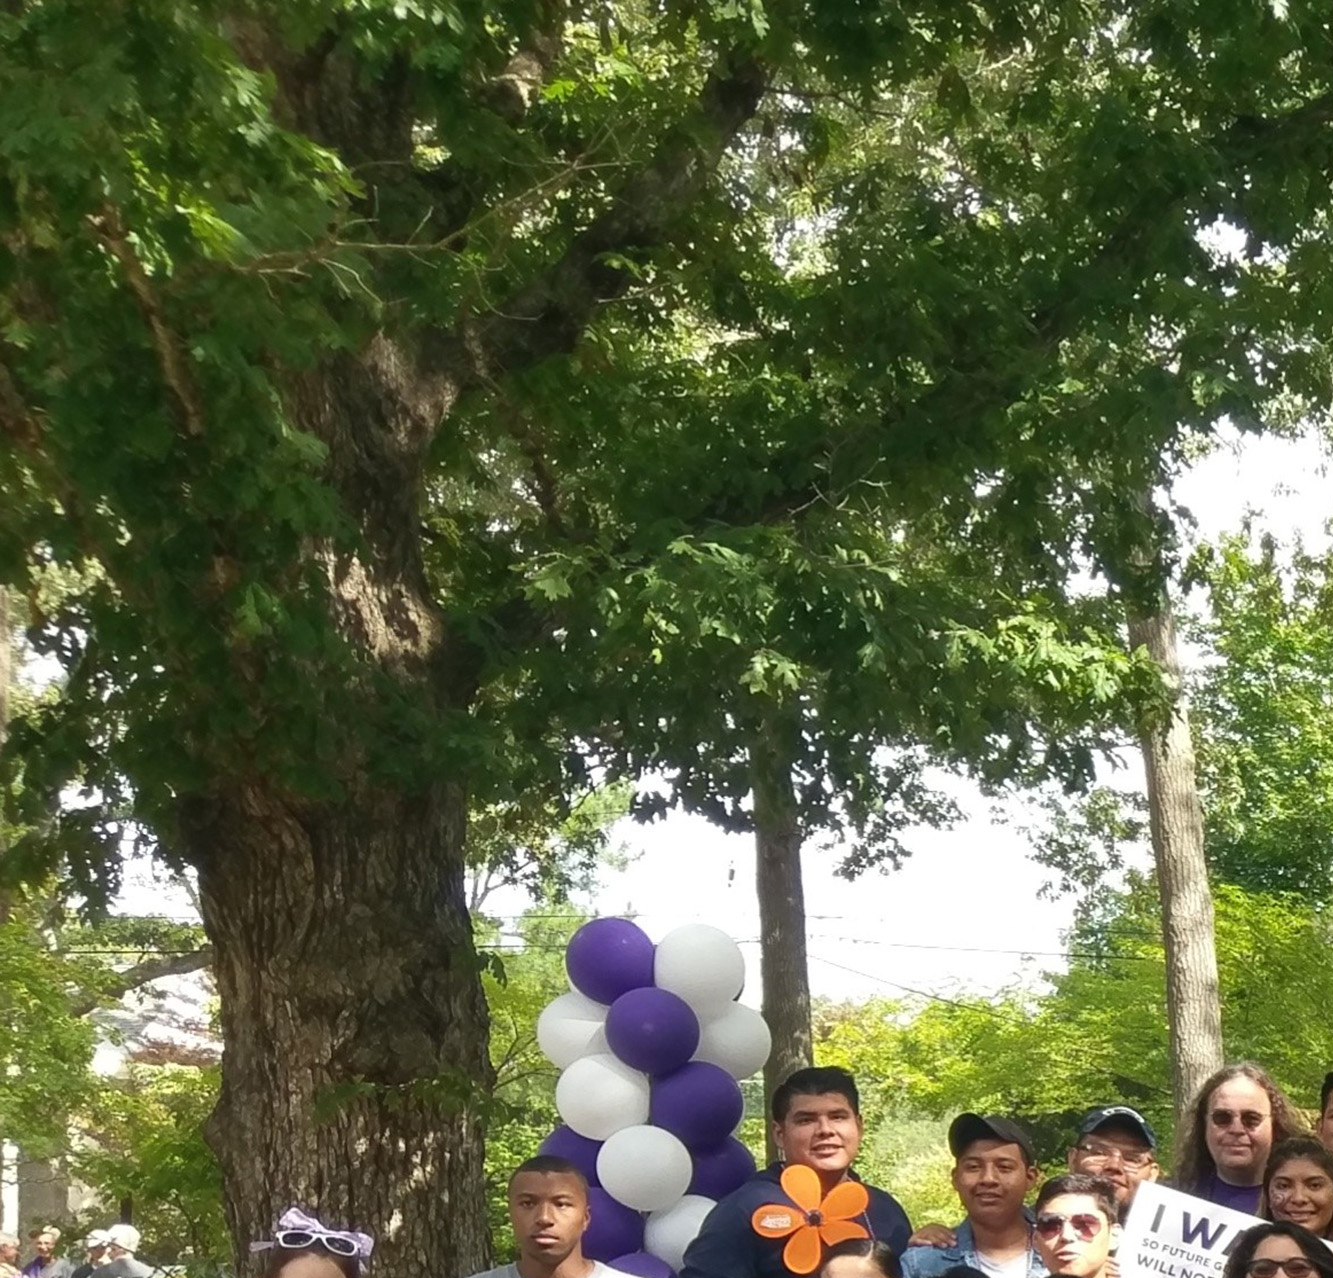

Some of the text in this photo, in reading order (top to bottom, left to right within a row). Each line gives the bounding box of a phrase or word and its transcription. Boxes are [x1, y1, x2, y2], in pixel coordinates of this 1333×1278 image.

[1149, 1203, 1166, 1234] I
[1137, 1253, 1176, 1277] WILL
[1142, 1238, 1159, 1250] SO
[1161, 1243, 1210, 1267] FUTURE
